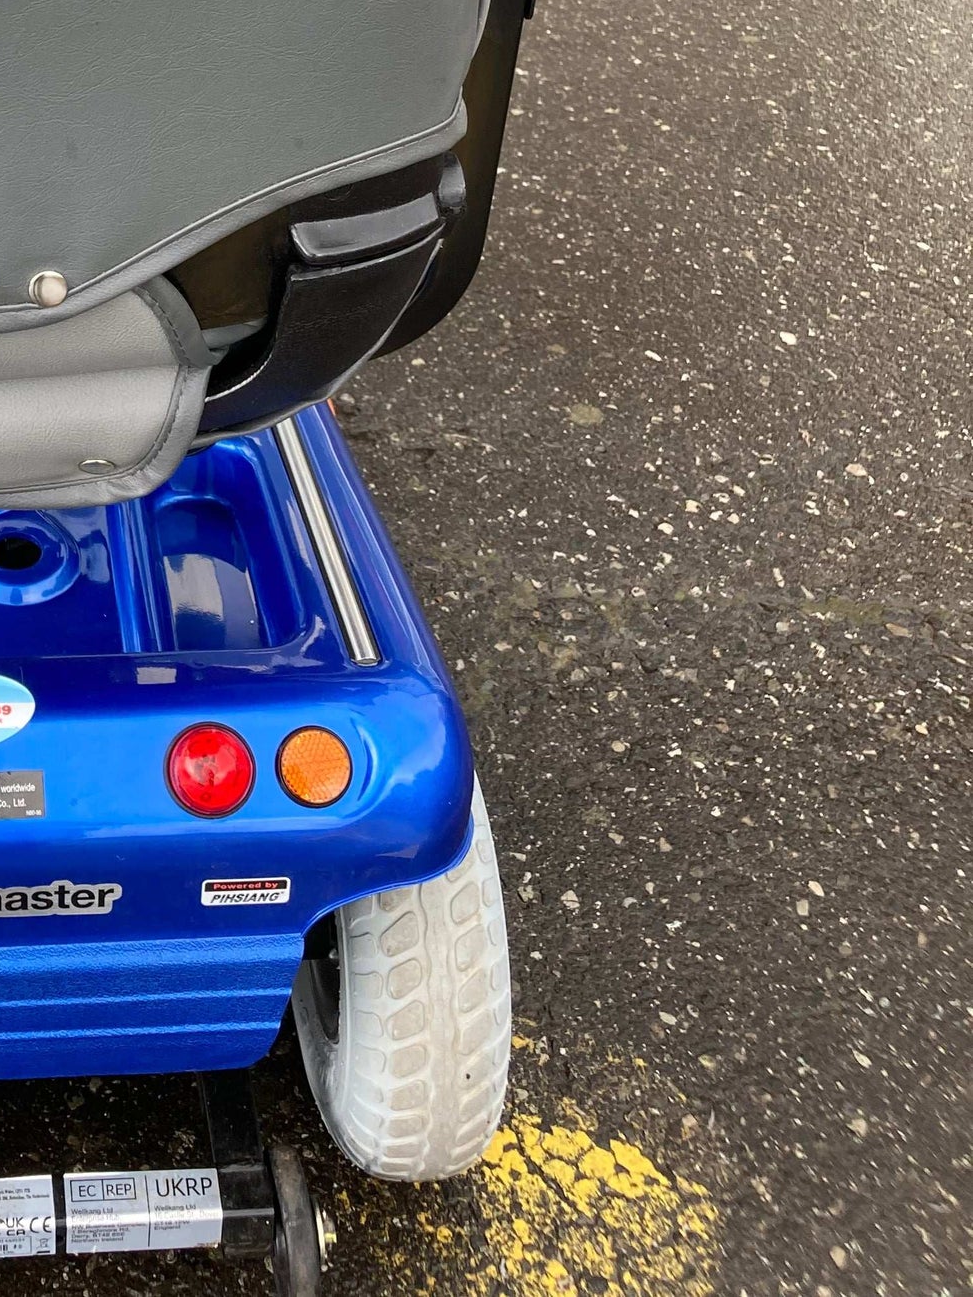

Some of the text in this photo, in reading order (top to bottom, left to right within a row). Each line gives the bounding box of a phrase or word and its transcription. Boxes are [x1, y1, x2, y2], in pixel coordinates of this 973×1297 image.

[0, 783, 36, 793] worldwide
[13, 798, 27, 807] Ltd.
[213, 882, 262, 890] Powered
[210, 892, 280, 903] PIHSIANG
[78, 1183, 132, 1197] EC REP
[156, 1177, 213, 1197] UKRP
[71, 1208, 101, 1216] Wellkang
[154, 1204, 184, 1212] Wellkang
[6, 1217, 25, 1228] UK
[29, 1215, 52, 1234] CE
